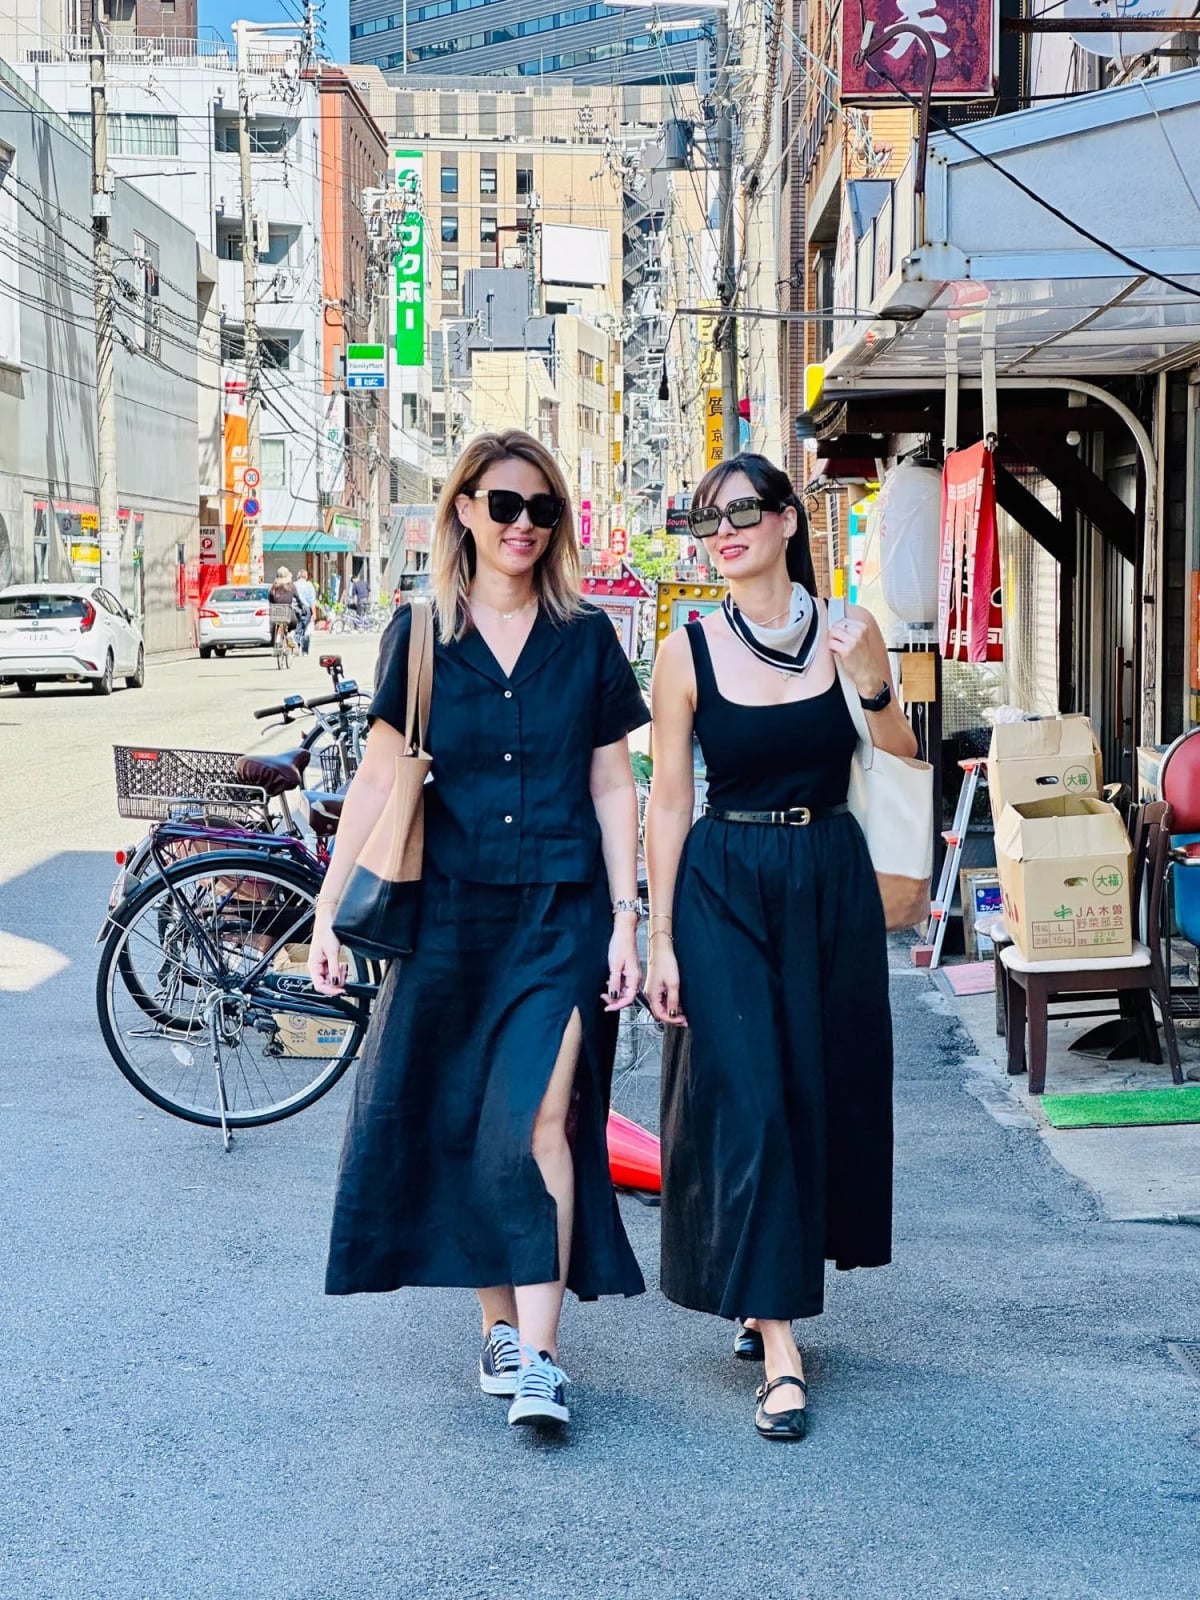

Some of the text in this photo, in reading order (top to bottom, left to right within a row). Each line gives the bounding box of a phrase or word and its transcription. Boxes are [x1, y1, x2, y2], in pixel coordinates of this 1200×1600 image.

[398, 225, 422, 329] フクホー
[349, 362, 383, 370] FamilyMart
[247, 473, 257, 482] 30
[204, 539, 212, 548] P
[1067, 772, 1089, 787] 大福
[1096, 873, 1120, 888] 大福
[1058, 923, 1065, 932] L
[1076, 916, 1123, 929] 野菜部会
